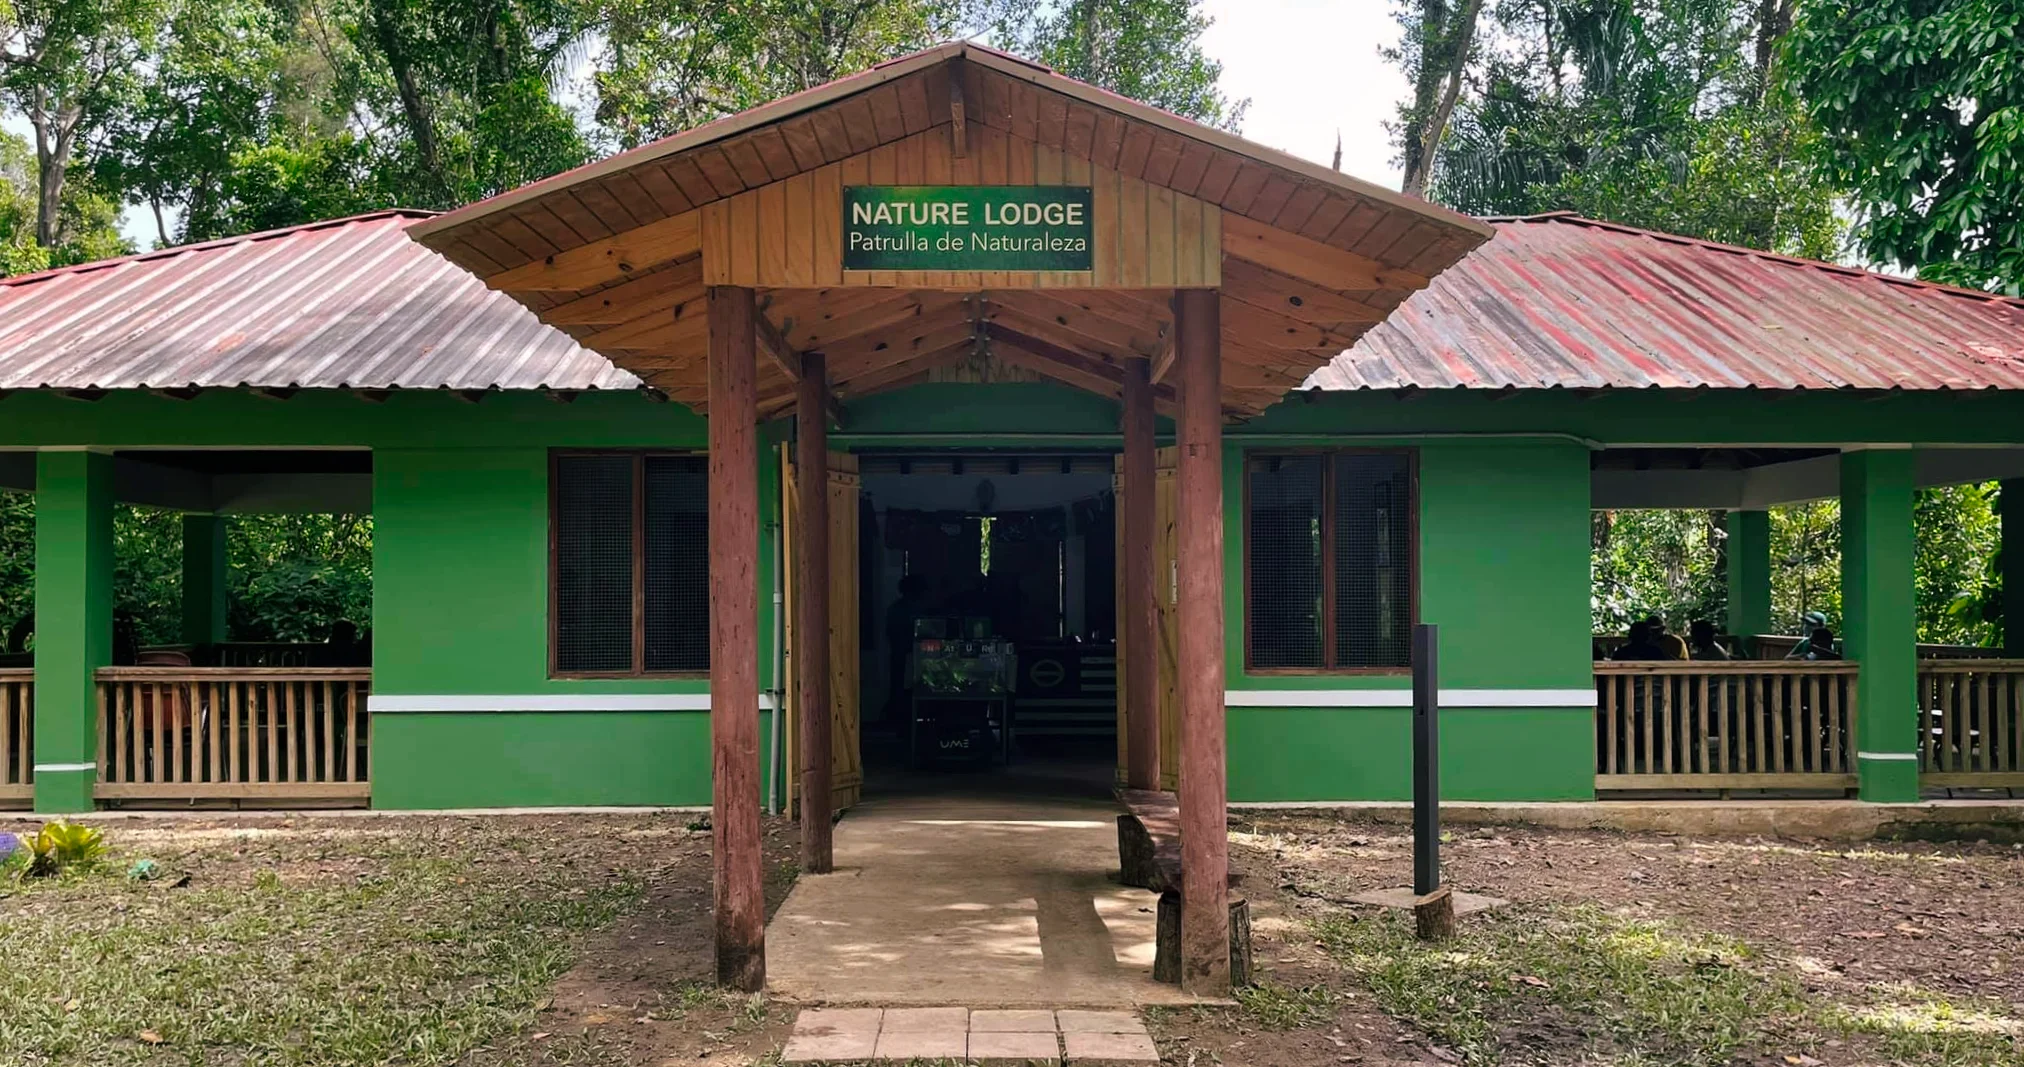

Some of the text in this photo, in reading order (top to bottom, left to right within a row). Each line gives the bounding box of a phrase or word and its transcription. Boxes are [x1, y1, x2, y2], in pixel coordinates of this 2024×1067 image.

[852, 202, 1084, 225] NATURE LODGE
[850, 231, 1086, 251] Patrulla de Naturaleza
